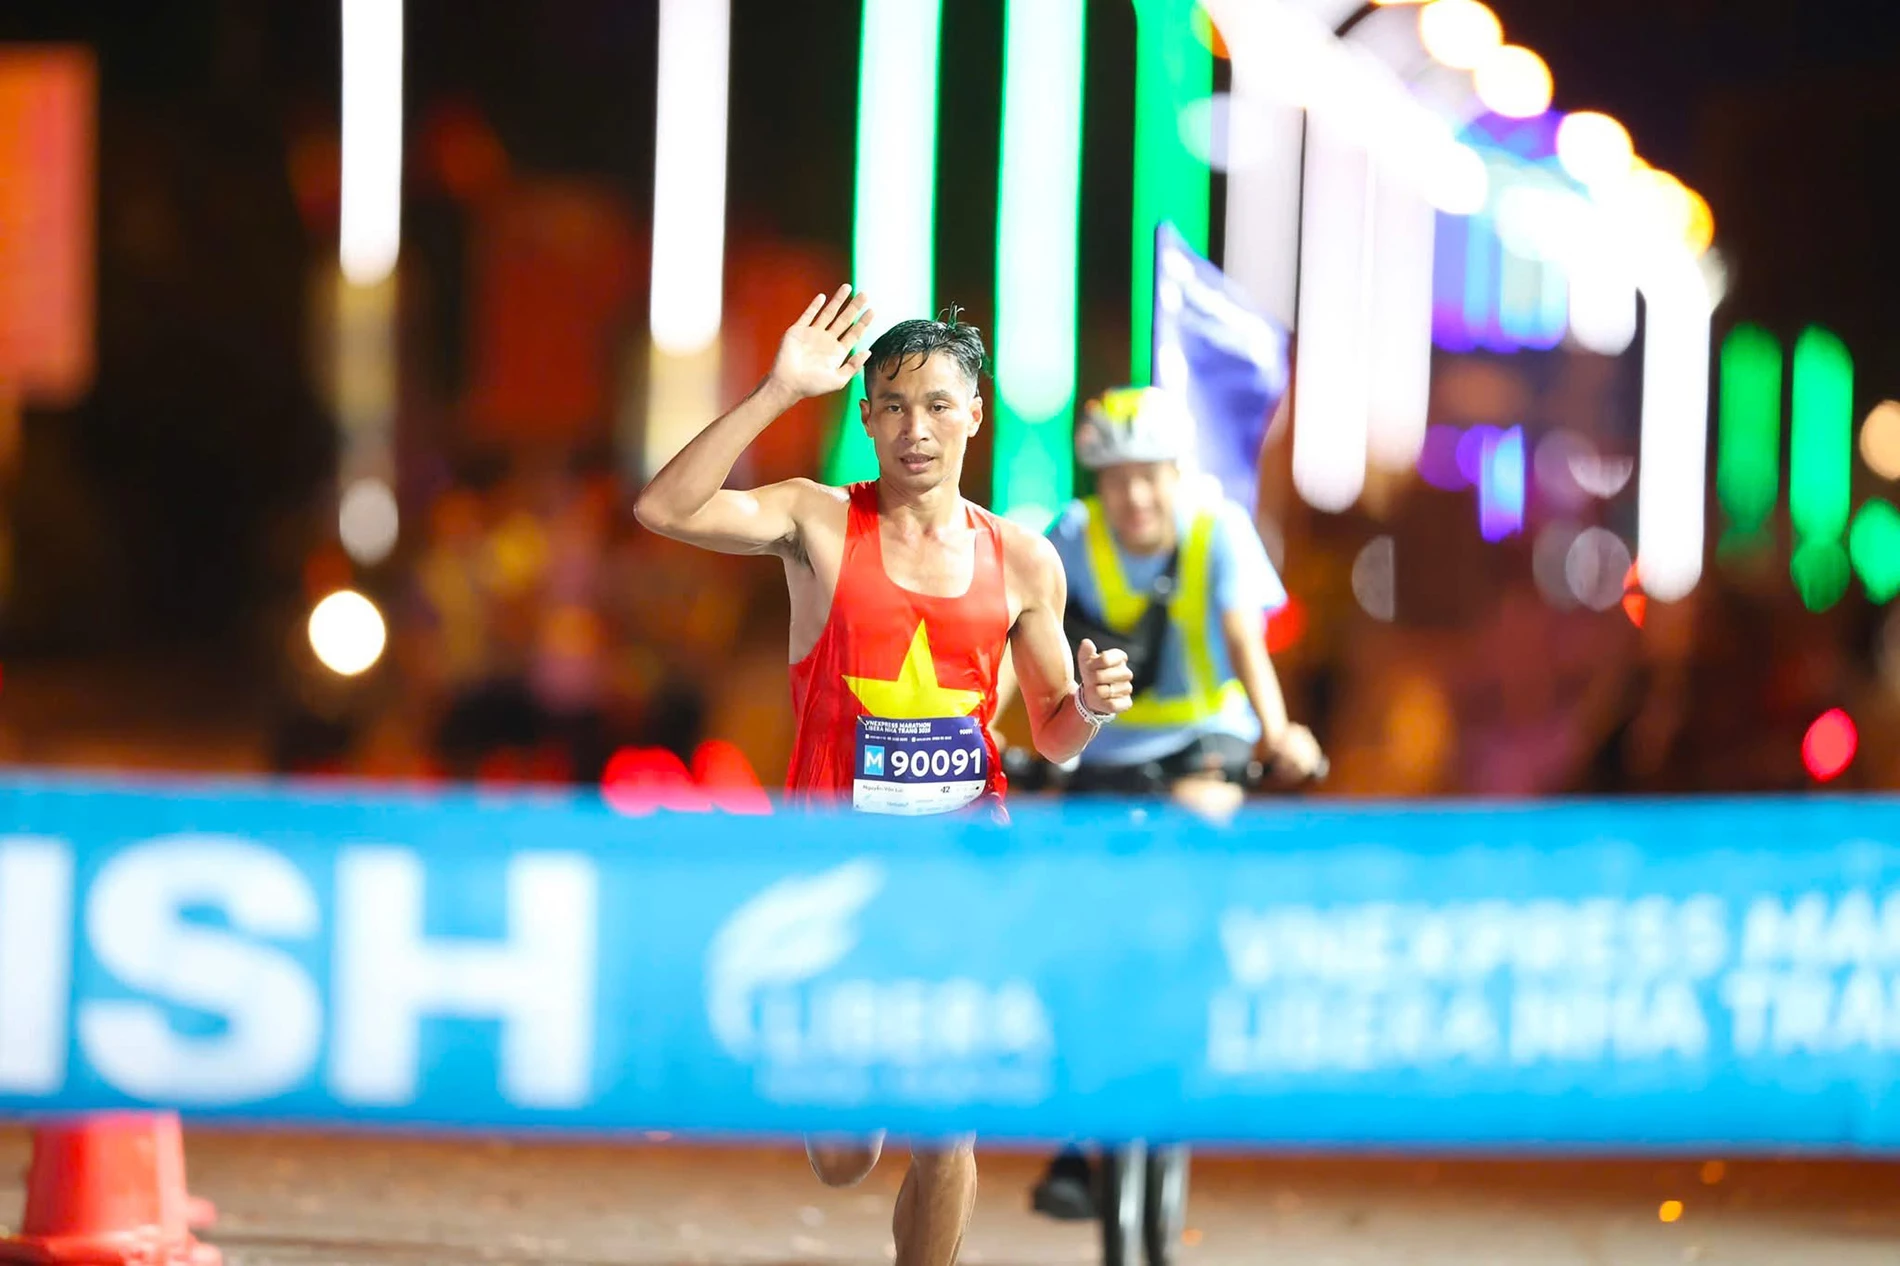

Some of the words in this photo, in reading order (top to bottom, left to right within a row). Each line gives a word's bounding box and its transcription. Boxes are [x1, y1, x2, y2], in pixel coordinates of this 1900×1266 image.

[866, 751, 881, 769] M
[890, 748, 981, 777] 90091
[1742, 889, 1900, 966] MA
[0, 834, 599, 1107] ISH
[1720, 968, 1900, 1056] TRA
